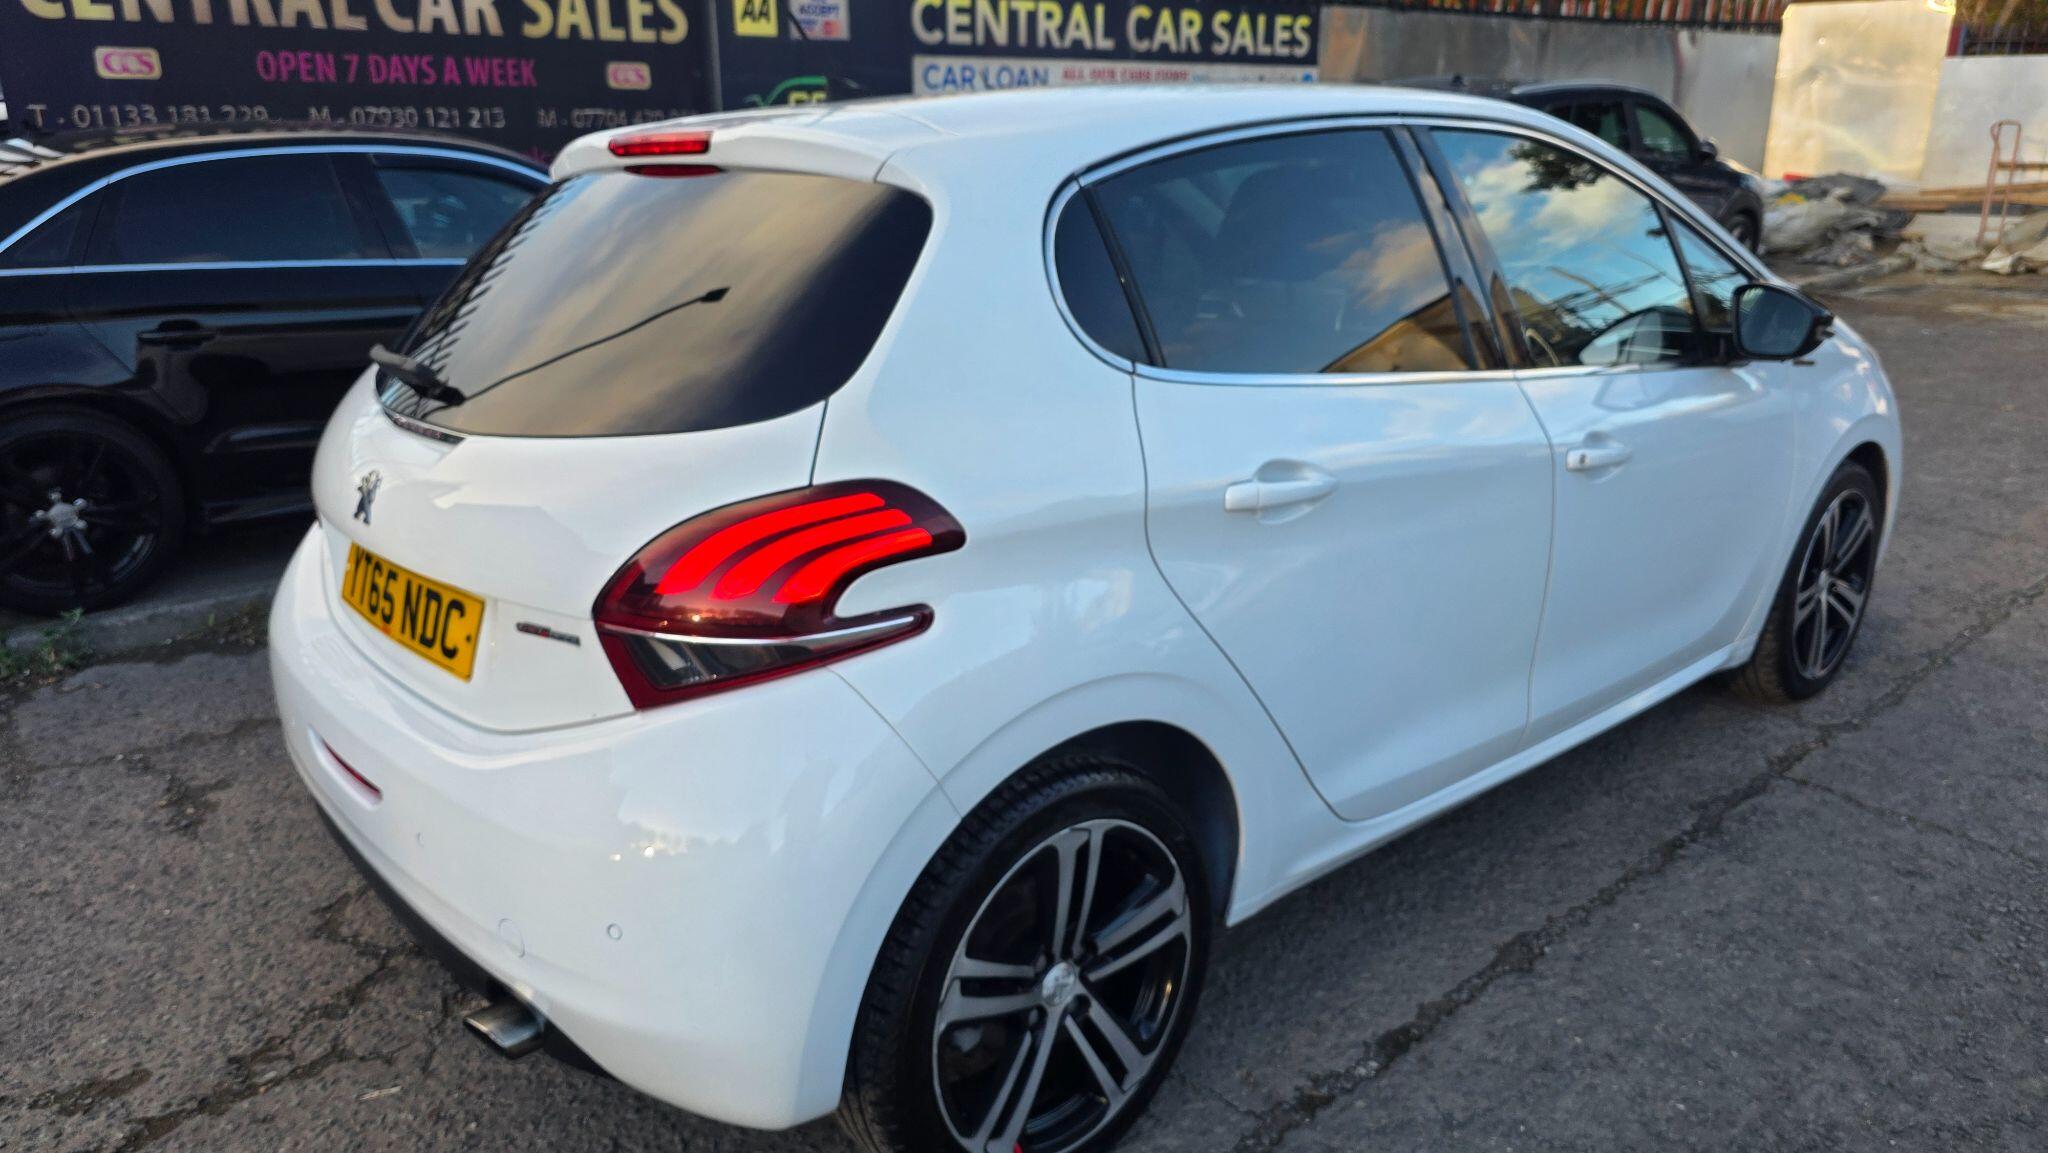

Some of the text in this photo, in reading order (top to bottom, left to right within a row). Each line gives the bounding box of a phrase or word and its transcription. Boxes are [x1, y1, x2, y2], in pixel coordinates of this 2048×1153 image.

[741, 0, 770, 23] AA
[911, 0, 1311, 58] CENTRAL CAR SALES
[257, 51, 537, 87] OPEN 7 DAYS A WEEK
[923, 63, 1049, 92] CAR LOAN
[27, 104, 47, 128] T
[310, 105, 331, 126] M
[424, 106, 460, 128] 121
[467, 107, 506, 128] 213
[537, 108, 557, 128] M
[350, 546, 465, 660] YT65 NDC
